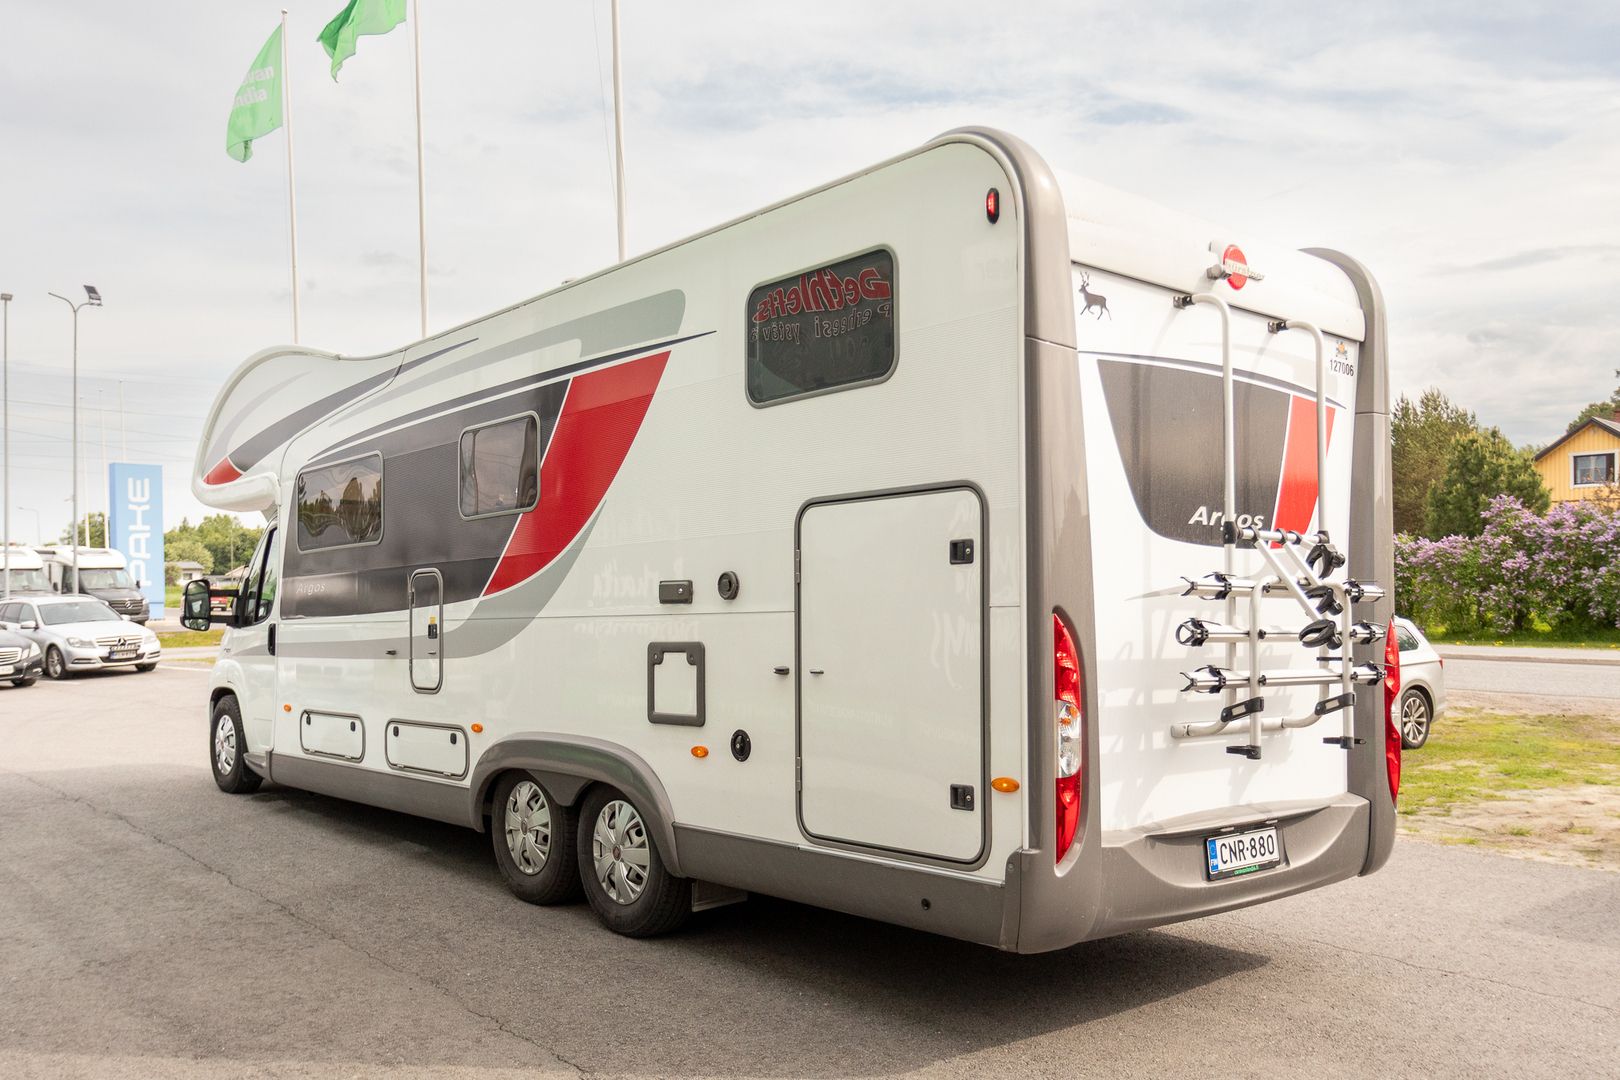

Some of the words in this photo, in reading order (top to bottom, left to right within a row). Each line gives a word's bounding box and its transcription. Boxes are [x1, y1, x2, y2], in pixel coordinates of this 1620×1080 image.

[1329, 359, 1355, 377] 127006
[295, 583, 326, 595] Argos
[1220, 834, 1274, 864] CNR-880
